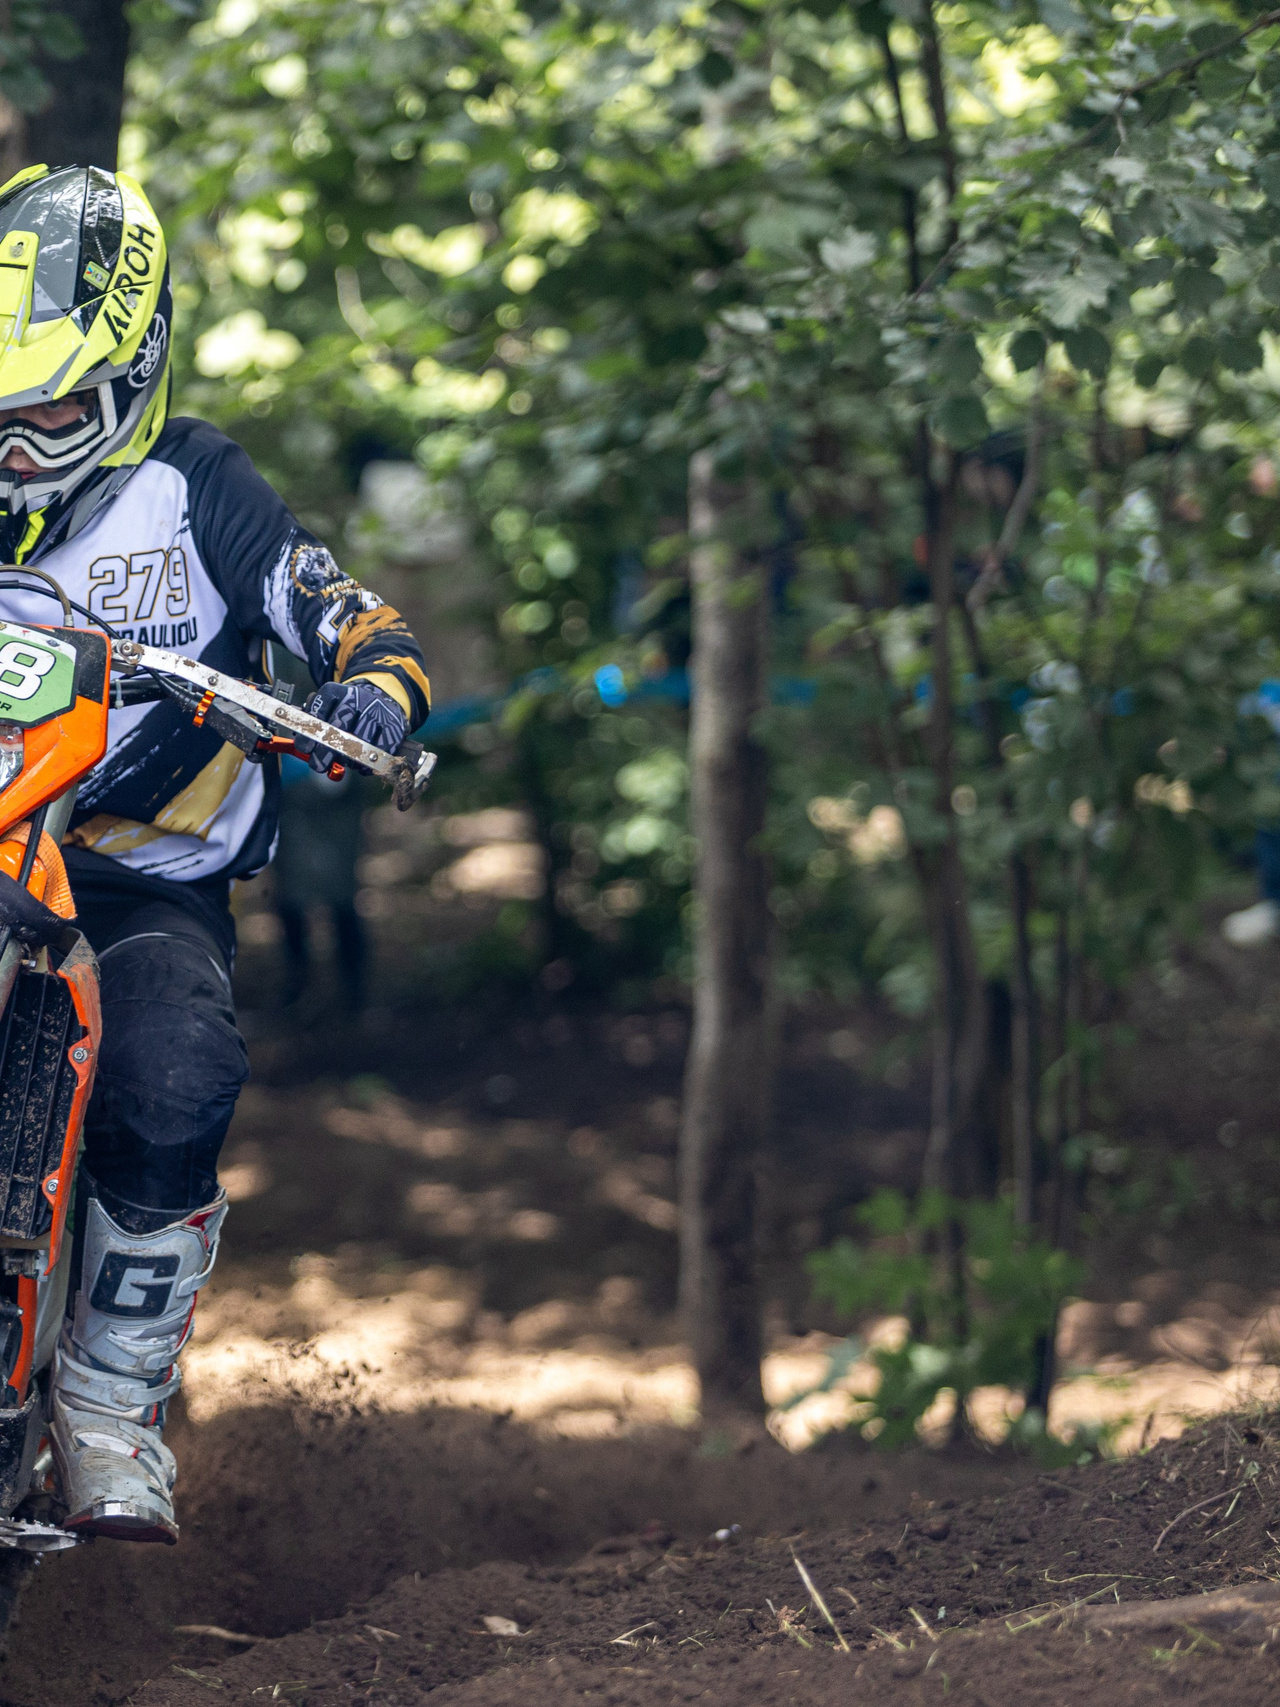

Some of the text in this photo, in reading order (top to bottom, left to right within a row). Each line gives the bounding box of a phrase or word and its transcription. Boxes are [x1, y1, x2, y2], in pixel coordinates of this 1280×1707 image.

[103, 223, 156, 346] AIROH
[87, 546, 191, 626] 279
[106, 616, 198, 648] RAULIOU
[90, 1250, 181, 1317] G
